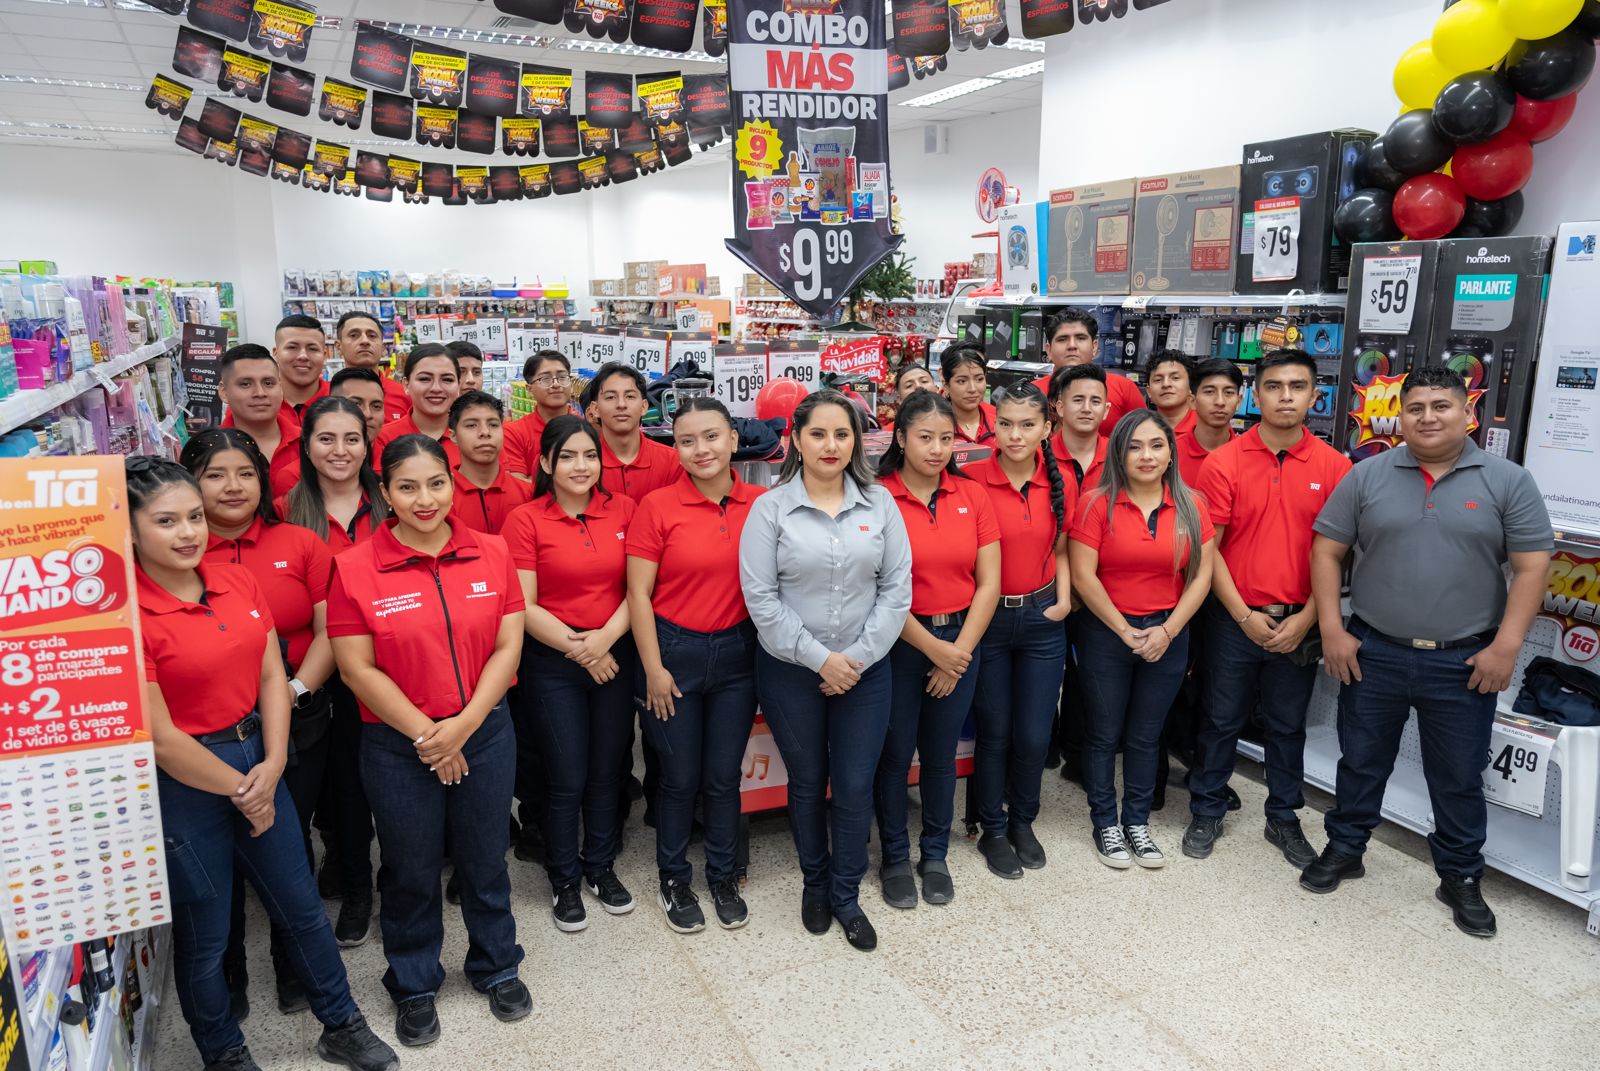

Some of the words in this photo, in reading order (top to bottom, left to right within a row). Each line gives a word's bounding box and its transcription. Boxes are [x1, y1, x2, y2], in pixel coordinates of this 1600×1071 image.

[276, 6, 306, 17] NOVIEMBRE
[279, 11, 307, 21] DICIEMBRE
[896, 7, 945, 19] DESCUENTOS
[1027, 3, 1069, 18] ESPERADOS
[640, 15, 690, 28] ESPERADOS
[964, 13, 993, 24] WEEKS
[746, 9, 869, 46] COMBO
[900, 24, 945, 36] ESPERADOS
[358, 45, 407, 62] DESCUENTOS
[358, 59, 403, 75] ESPERADOS
[766, 41, 854, 91] MÁS
[470, 76, 516, 86] DESCUENTOS
[472, 89, 514, 99] ESPERADOS
[687, 91, 726, 100] DESCUENTOS
[692, 102, 727, 112] ESPERADOS
[742, 93, 877, 120] RENDIDOR
[749, 127, 772, 136] INCLUYE
[749, 135, 767, 160] 9
[740, 159, 773, 169] PRODUCTOS
[1247, 154, 1274, 164] hometech
[1141, 181, 1166, 190] samurai
[1261, 226, 1291, 257] $79
[1466, 254, 1511, 264] hometech
[1459, 280, 1512, 295] PARLANTE
[1371, 280, 1409, 314] $59
[824, 348, 880, 373] Navidad
[26, 468, 99, 508] Tía
[1310, 482, 1320, 491] Tía
[16, 524, 30, 533] la
[33, 518, 77, 534] promo
[80, 513, 105, 525] que
[8, 533, 40, 546] hace
[43, 526, 86, 541] vibrar!
[471, 581, 486, 592] Tía
[376, 603, 422, 618] experiencia
[0, 640, 25, 651] Por
[29, 636, 68, 650] cada
[1569, 632, 1596, 654] Tía
[35, 651, 55, 662] de
[59, 644, 129, 659] compras
[1, 653, 34, 686] 8
[36, 663, 53, 671] en
[57, 657, 105, 669] marcas
[37, 665, 123, 684] participantes
[70, 700, 128, 716] Llévate
[6, 727, 14, 737] 1
[18, 724, 42, 736] set
[46, 721, 65, 733] de
[69, 719, 79, 730] 6
[82, 716, 125, 728] vasos
[2, 738, 22, 750] de
[26, 732, 68, 747] vidrio
[72, 730, 90, 742] de
[93, 728, 110, 738] 10
[114, 726, 132, 736] oz
[1487, 744, 1538, 783] $4.99
